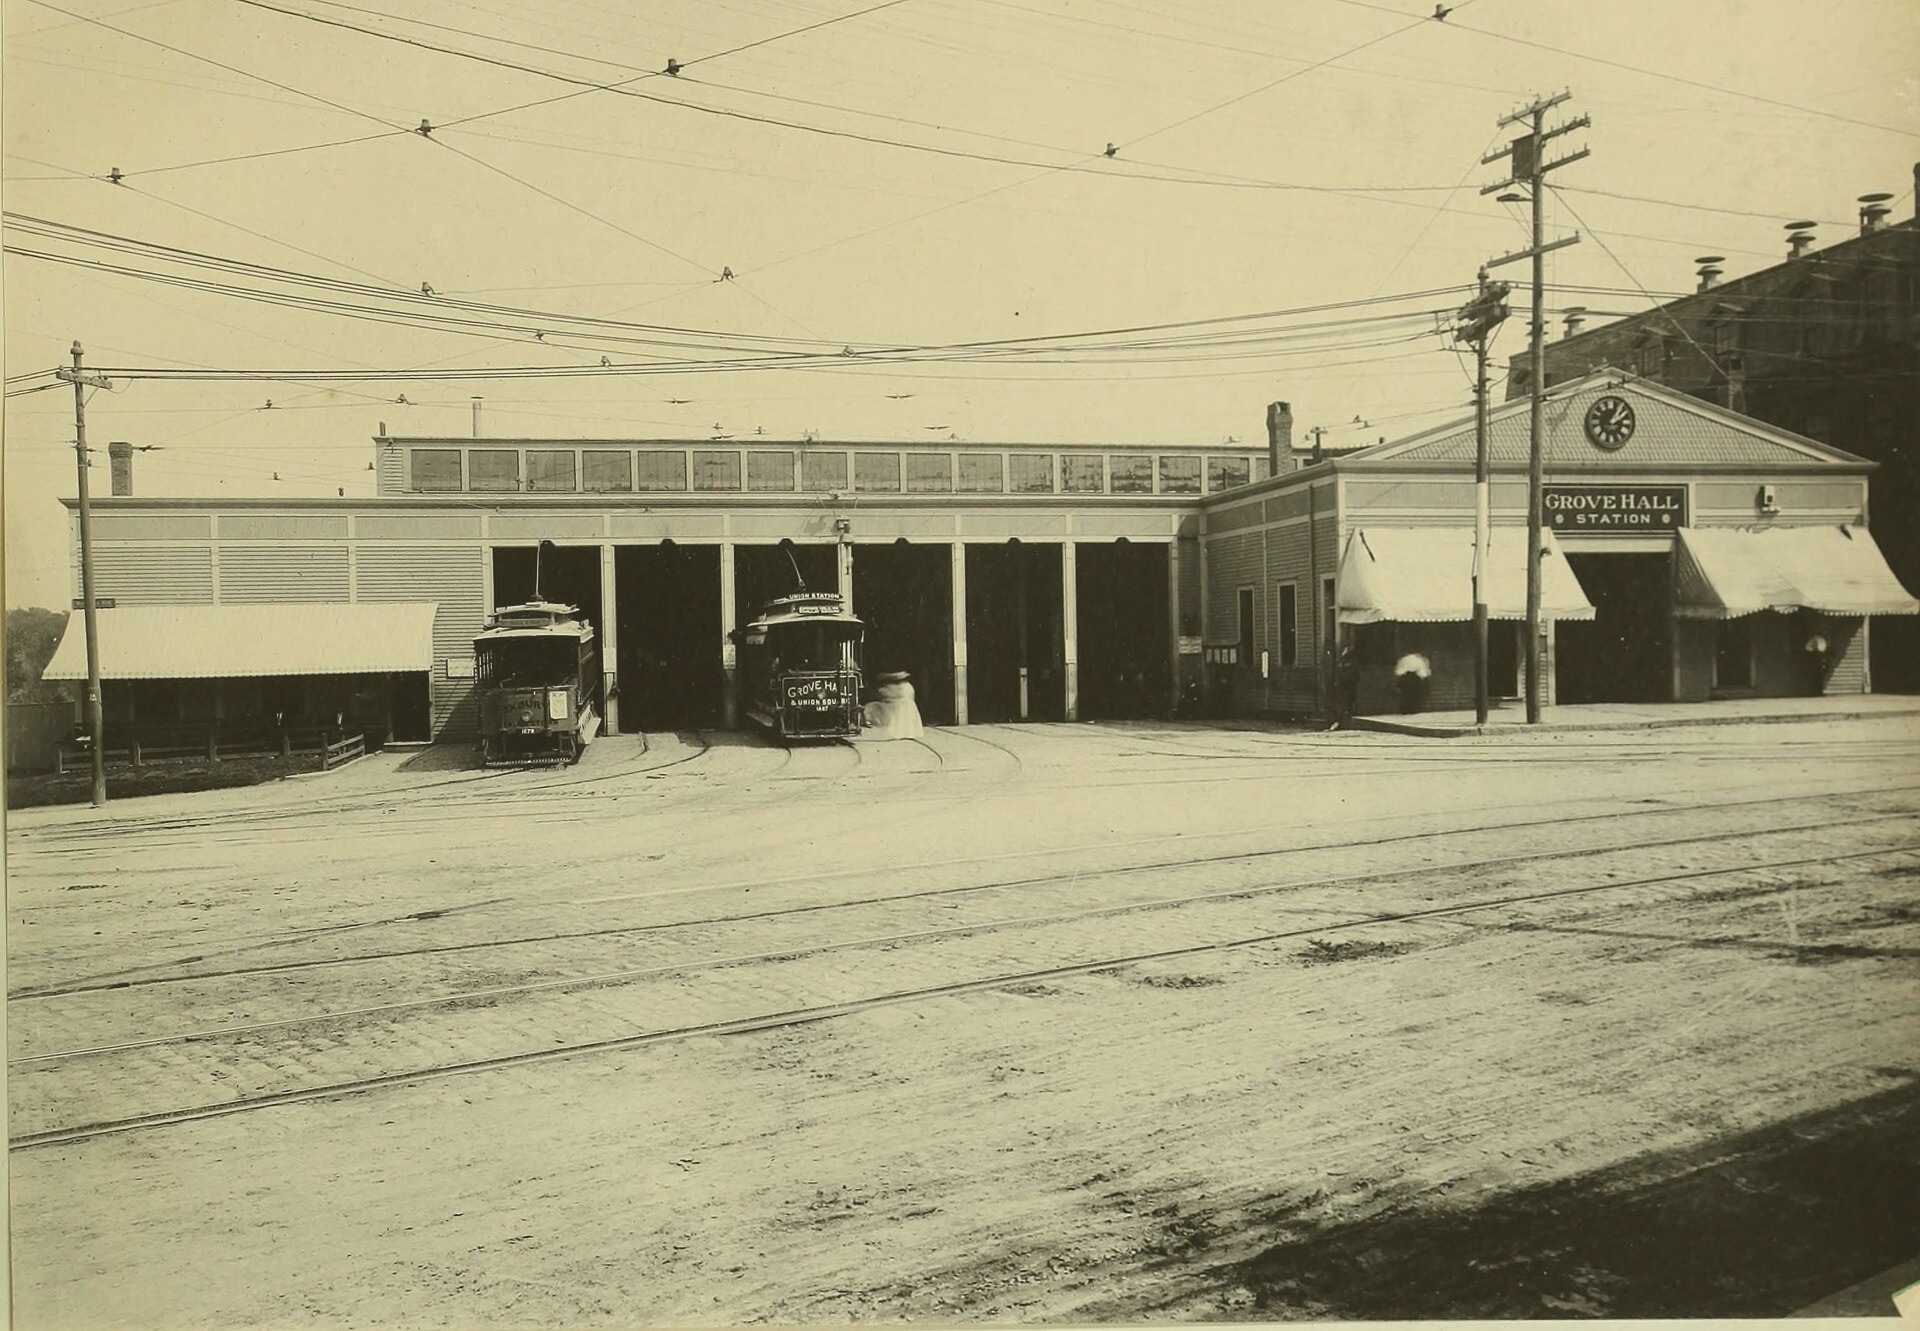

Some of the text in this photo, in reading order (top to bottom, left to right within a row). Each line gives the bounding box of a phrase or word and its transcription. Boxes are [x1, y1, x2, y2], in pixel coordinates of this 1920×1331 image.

[1545, 493, 1679, 510] GROVE HALL
[1576, 513, 1651, 525] STATION
[811, 592, 840, 600] STATION
[787, 680, 822, 698] GROVE
